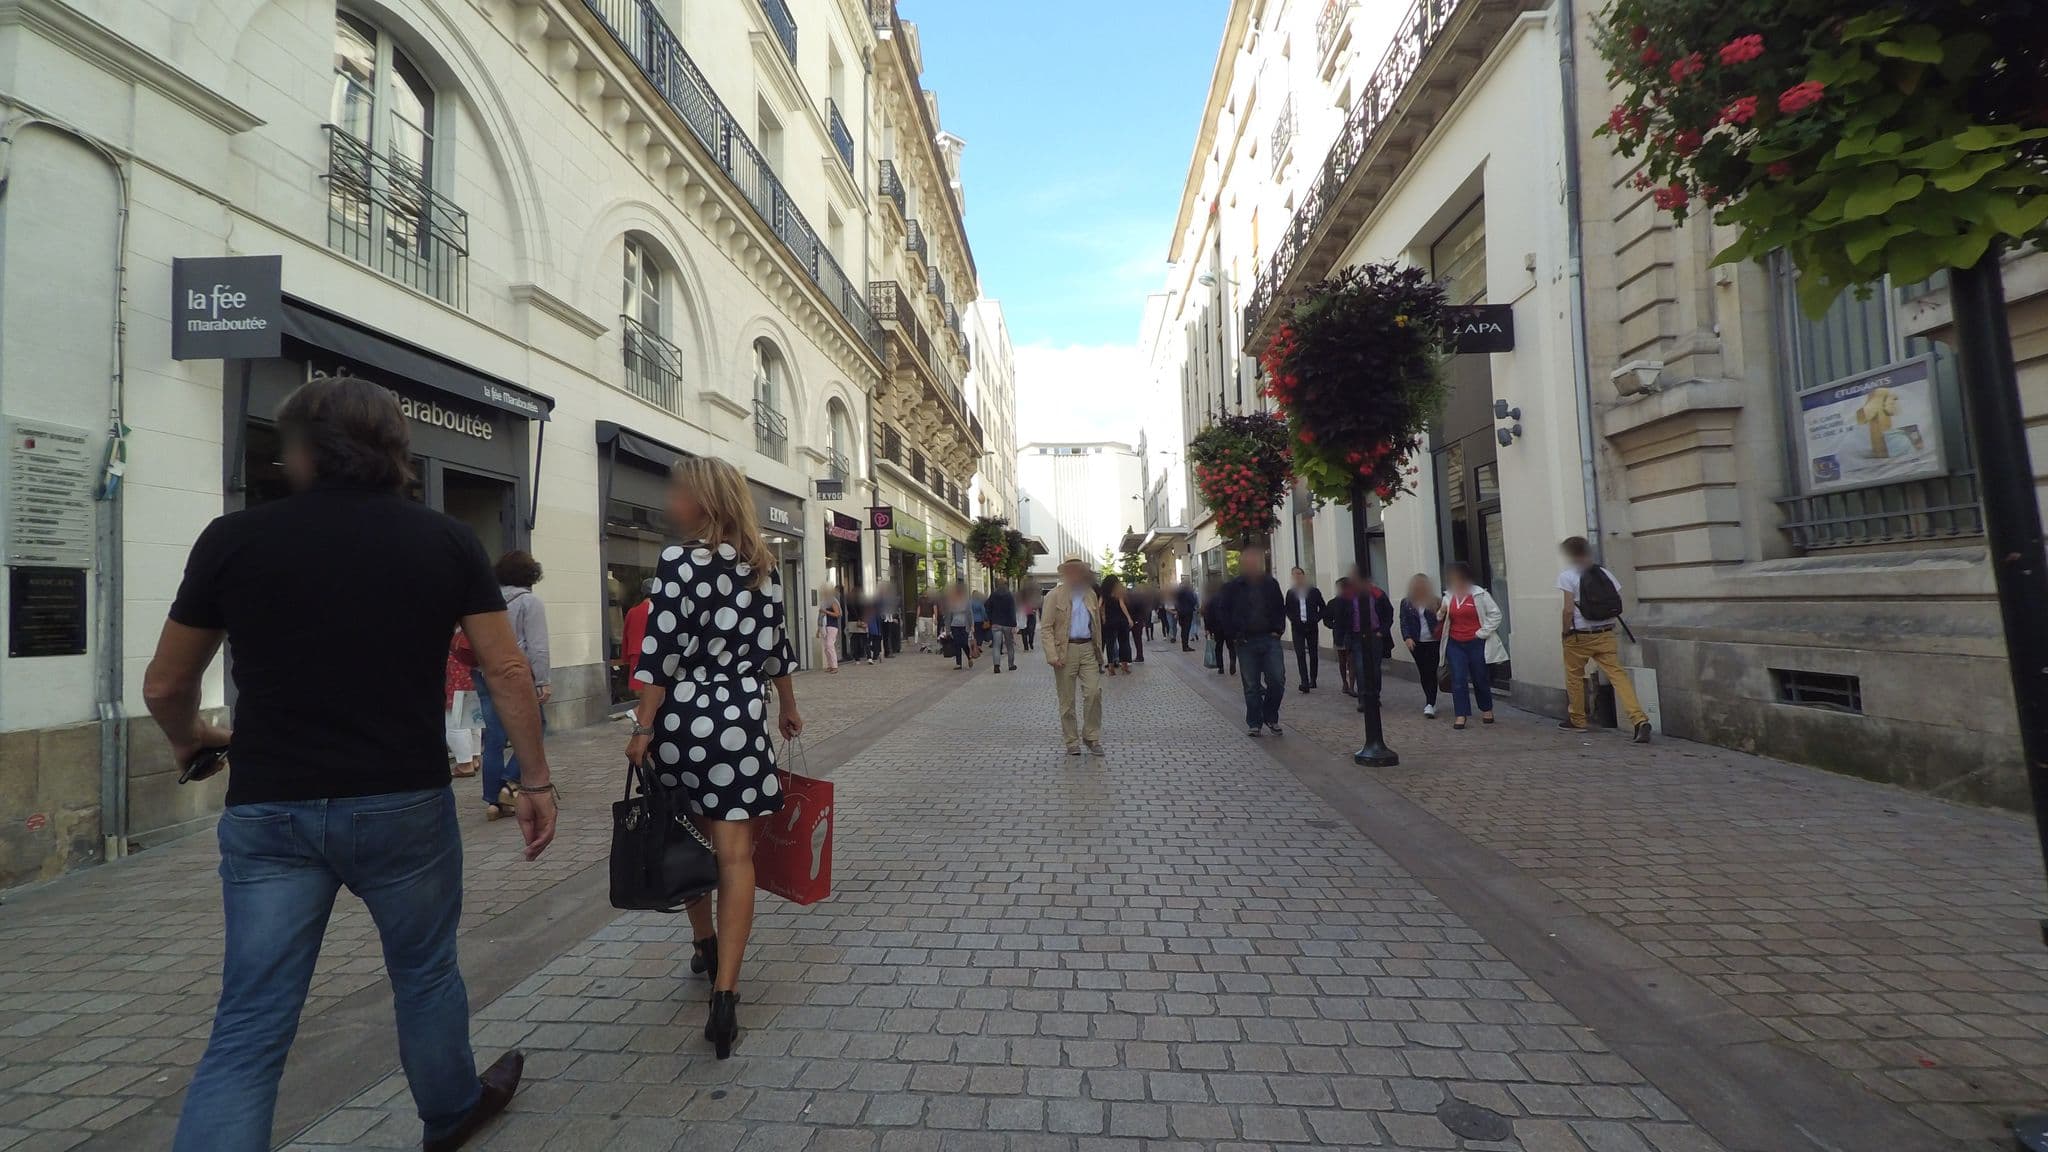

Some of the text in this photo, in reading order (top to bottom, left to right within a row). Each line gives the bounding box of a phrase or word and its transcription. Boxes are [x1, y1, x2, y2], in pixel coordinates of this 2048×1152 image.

[187, 284, 247, 320] la fée
[187, 316, 267, 332] maraboutée
[483, 385, 491, 398] la
[817, 492, 842, 501] EKYOG
